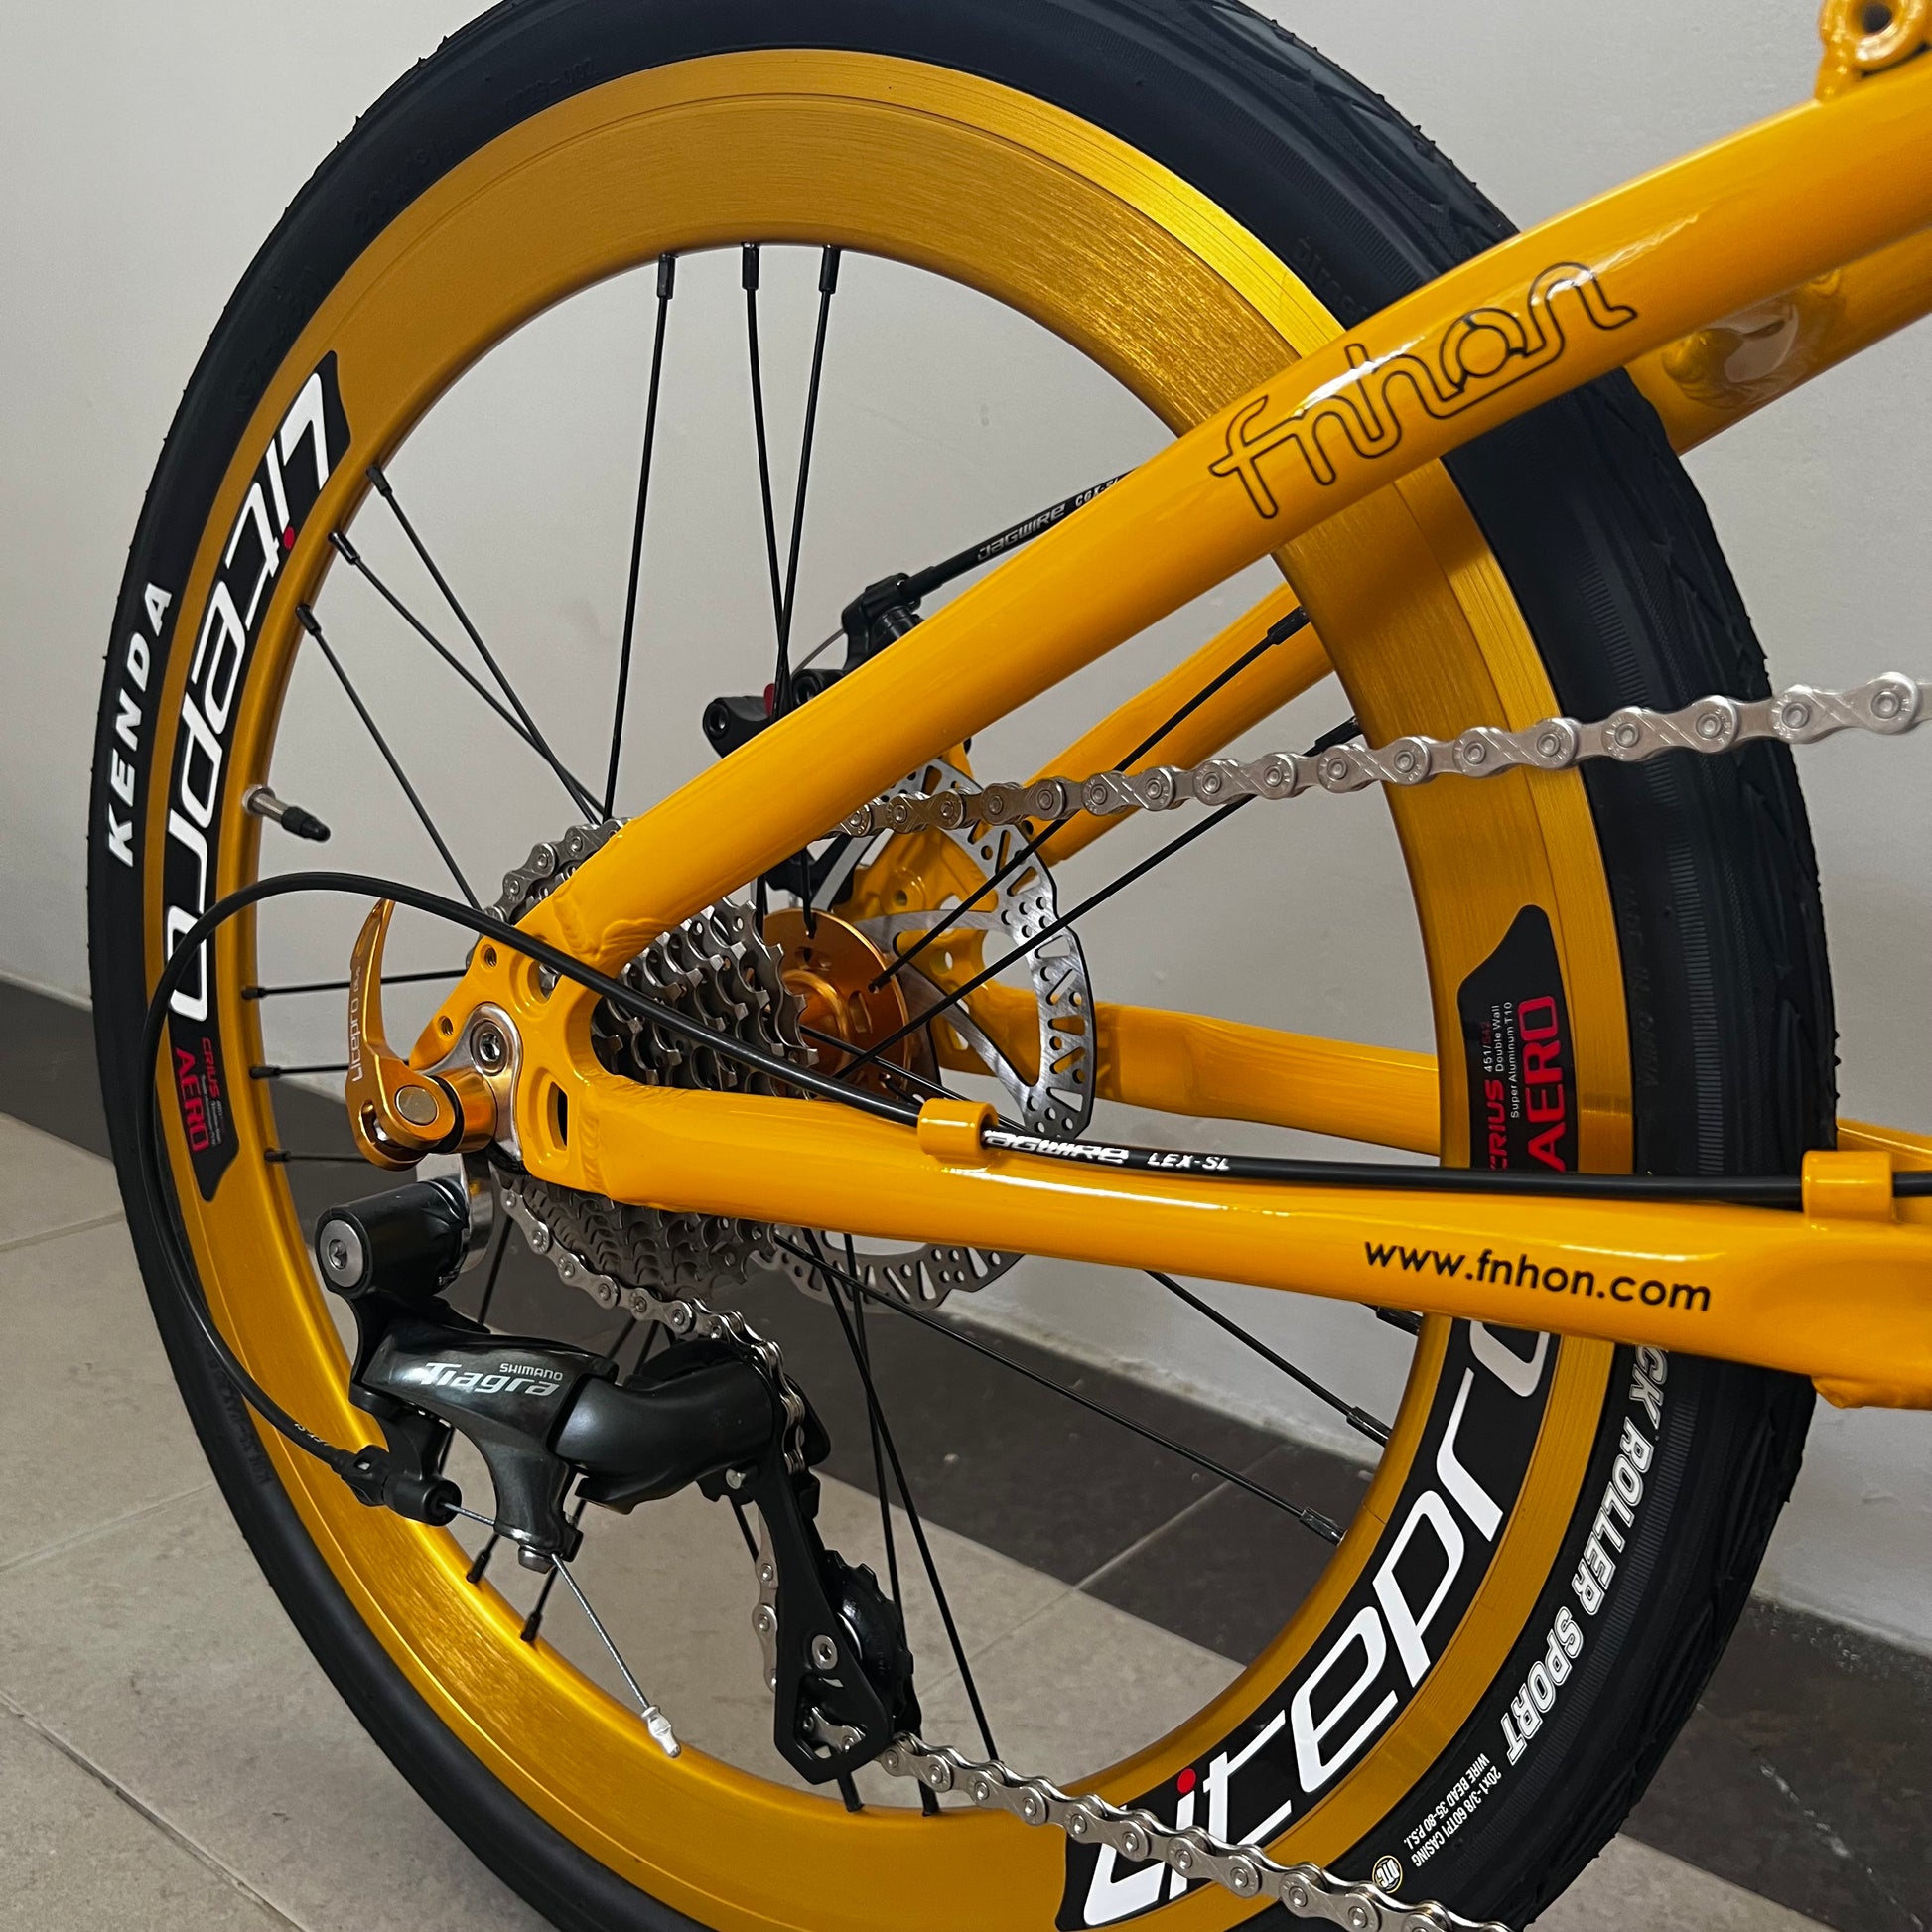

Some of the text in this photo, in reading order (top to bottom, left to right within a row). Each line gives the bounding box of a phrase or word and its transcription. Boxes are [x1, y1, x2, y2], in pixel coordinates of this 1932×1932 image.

[1209, 262, 1638, 519] fnhon
[108, 582, 172, 867] KENDA
[202, 1037, 220, 1098] CRIUS
[1491, 1005, 1504, 1072] Double Wall
[1503, 1002, 1520, 1118] Super Aluminum T10
[1518, 996, 1566, 1173] AERO
[175, 1047, 209, 1151] AERO
[982, 1130, 1230, 1171] AGWIRE LEX-SL
[1364, 1241, 1711, 1311] www.fnhon.com
[421, 1362, 560, 1396] Tiagra
[499, 1363, 563, 1381] SHIMANO
[1571, 1416, 1655, 1616] ROLLER
[1500, 1606, 1584, 1766] SPORT
[1403, 1753, 1490, 1849] WIRE BEAD 35-80 P.S.I.
[1411, 1766, 1501, 1866] 20x1-3/8 60TPI CASING
